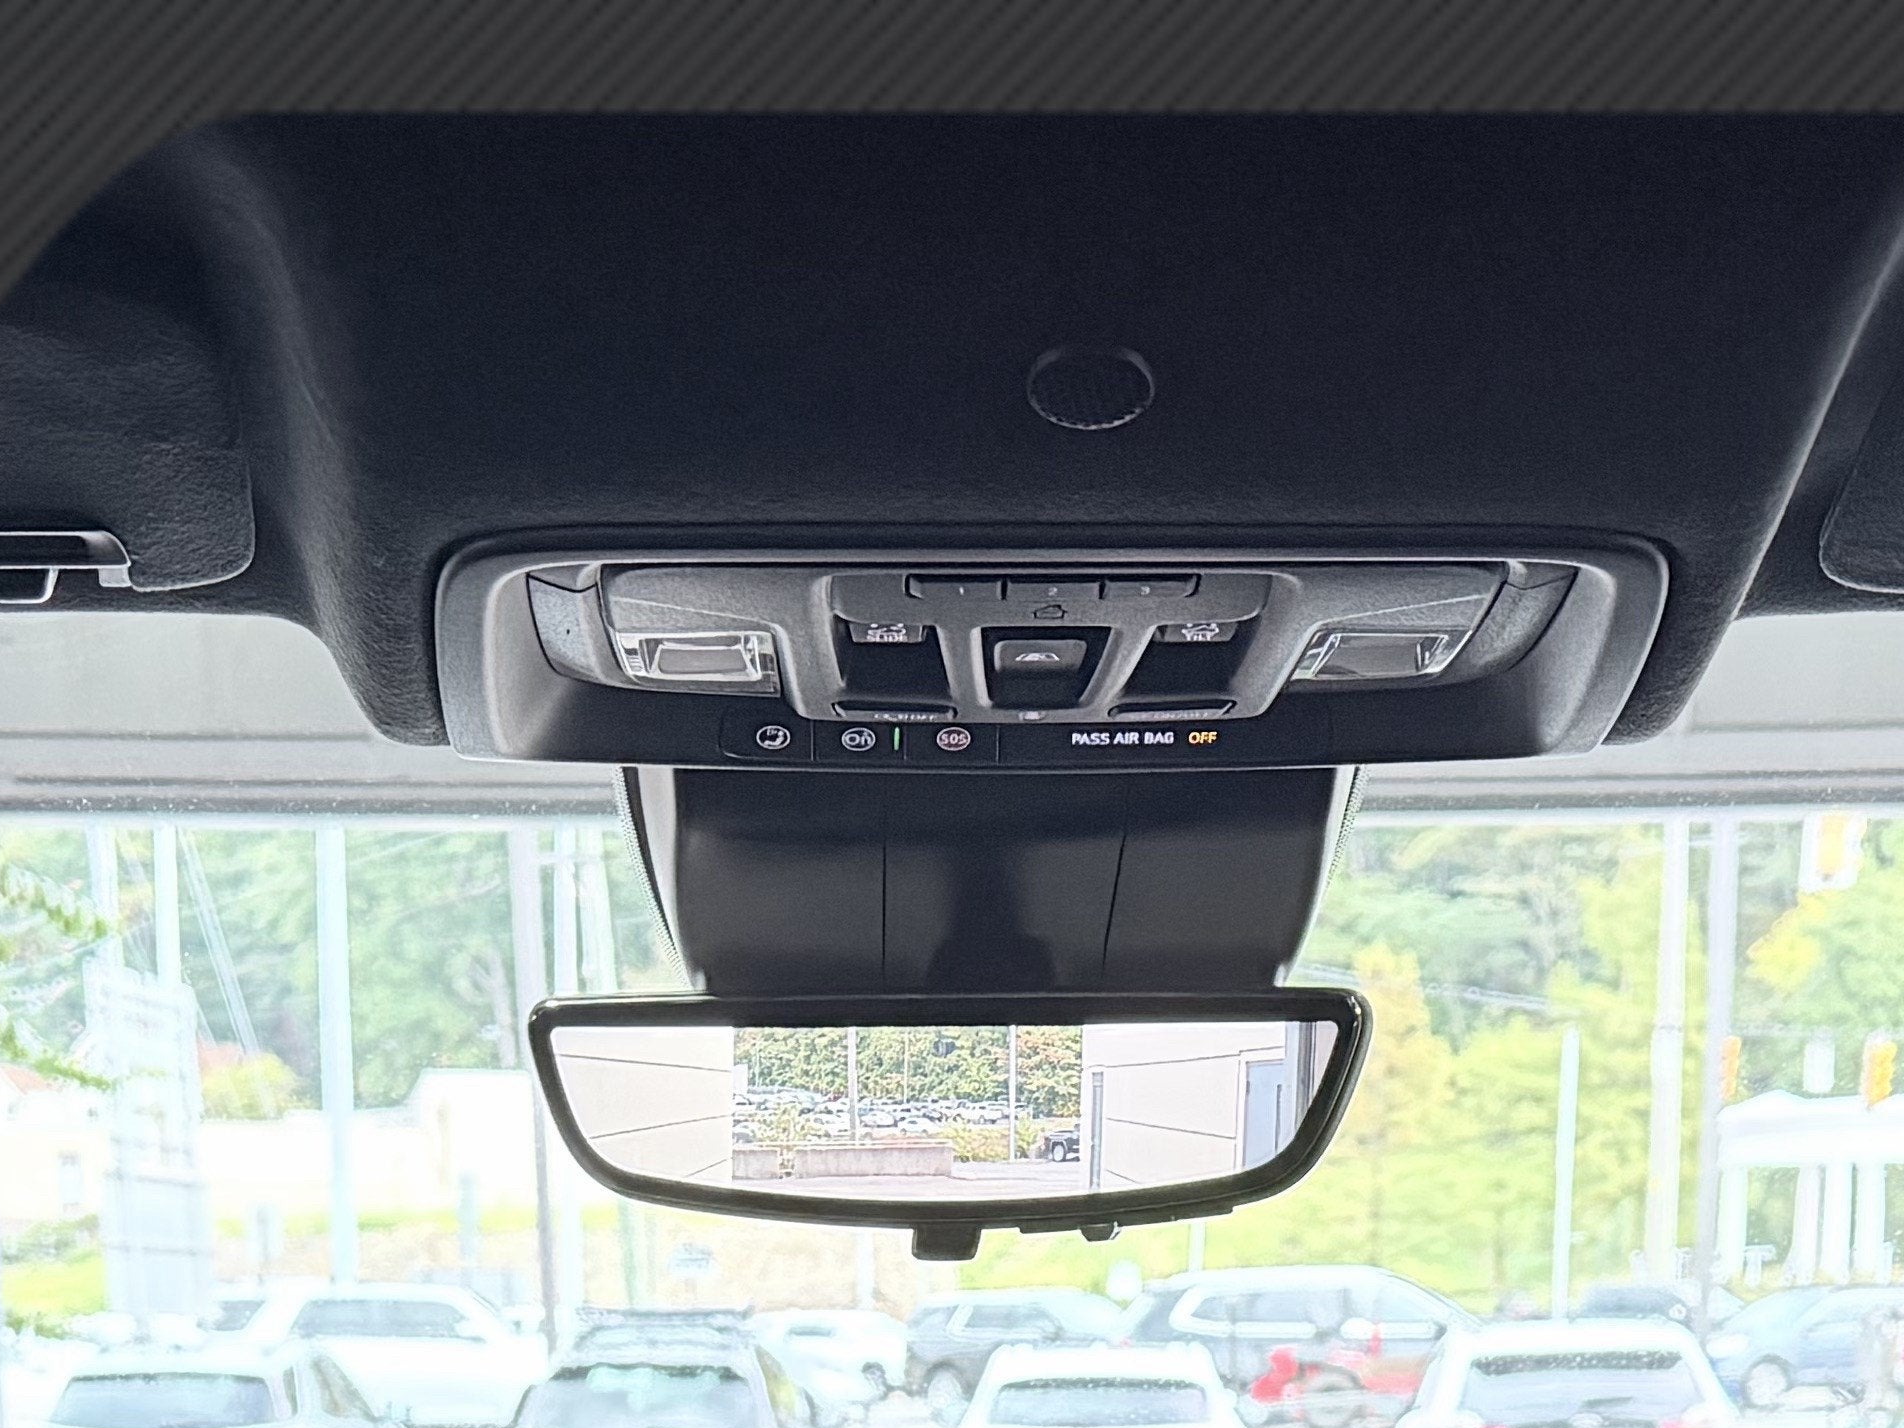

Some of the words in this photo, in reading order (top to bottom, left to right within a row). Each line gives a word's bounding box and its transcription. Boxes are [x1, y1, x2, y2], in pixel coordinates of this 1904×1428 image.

[938, 732, 969, 745] SOS
[1071, 732, 1110, 746] PASS
[1114, 732, 1139, 745] AIR
[1143, 732, 1175, 744] BAG
[1188, 731, 1218, 744] OFF
